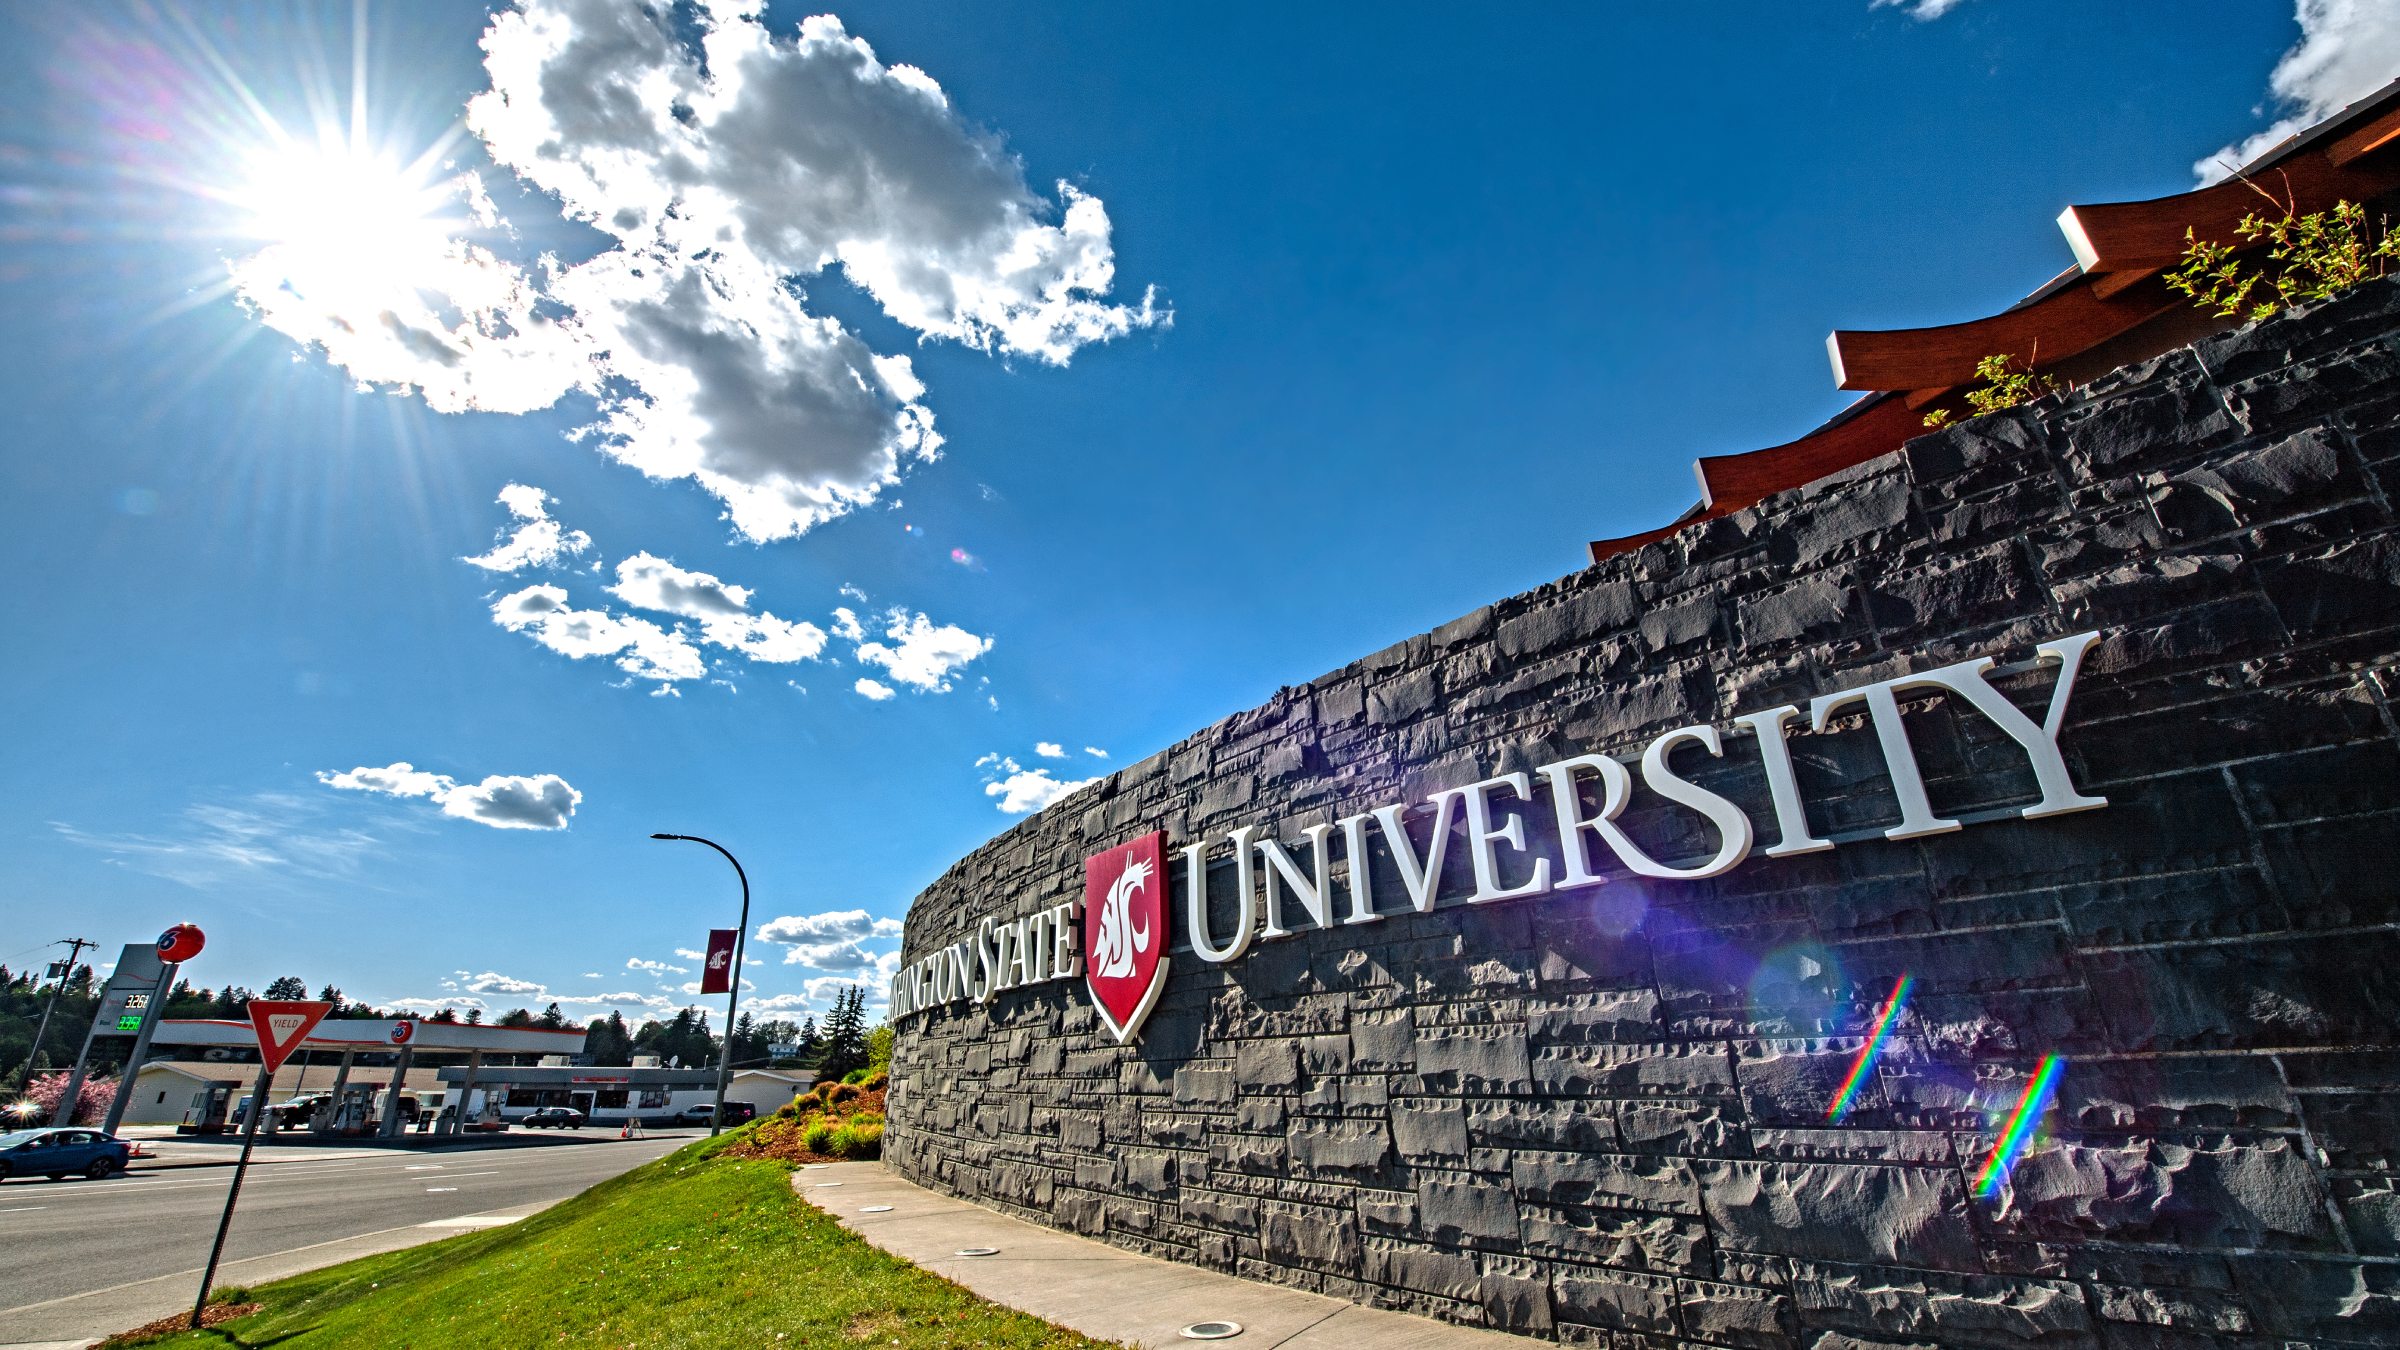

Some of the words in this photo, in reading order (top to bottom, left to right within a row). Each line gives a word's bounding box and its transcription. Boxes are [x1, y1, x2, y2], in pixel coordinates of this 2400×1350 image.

[974, 901, 1084, 1003] STATE
[1180, 631, 2108, 963] UNIVERSITY
[273, 1019, 299, 1028] YIELD
